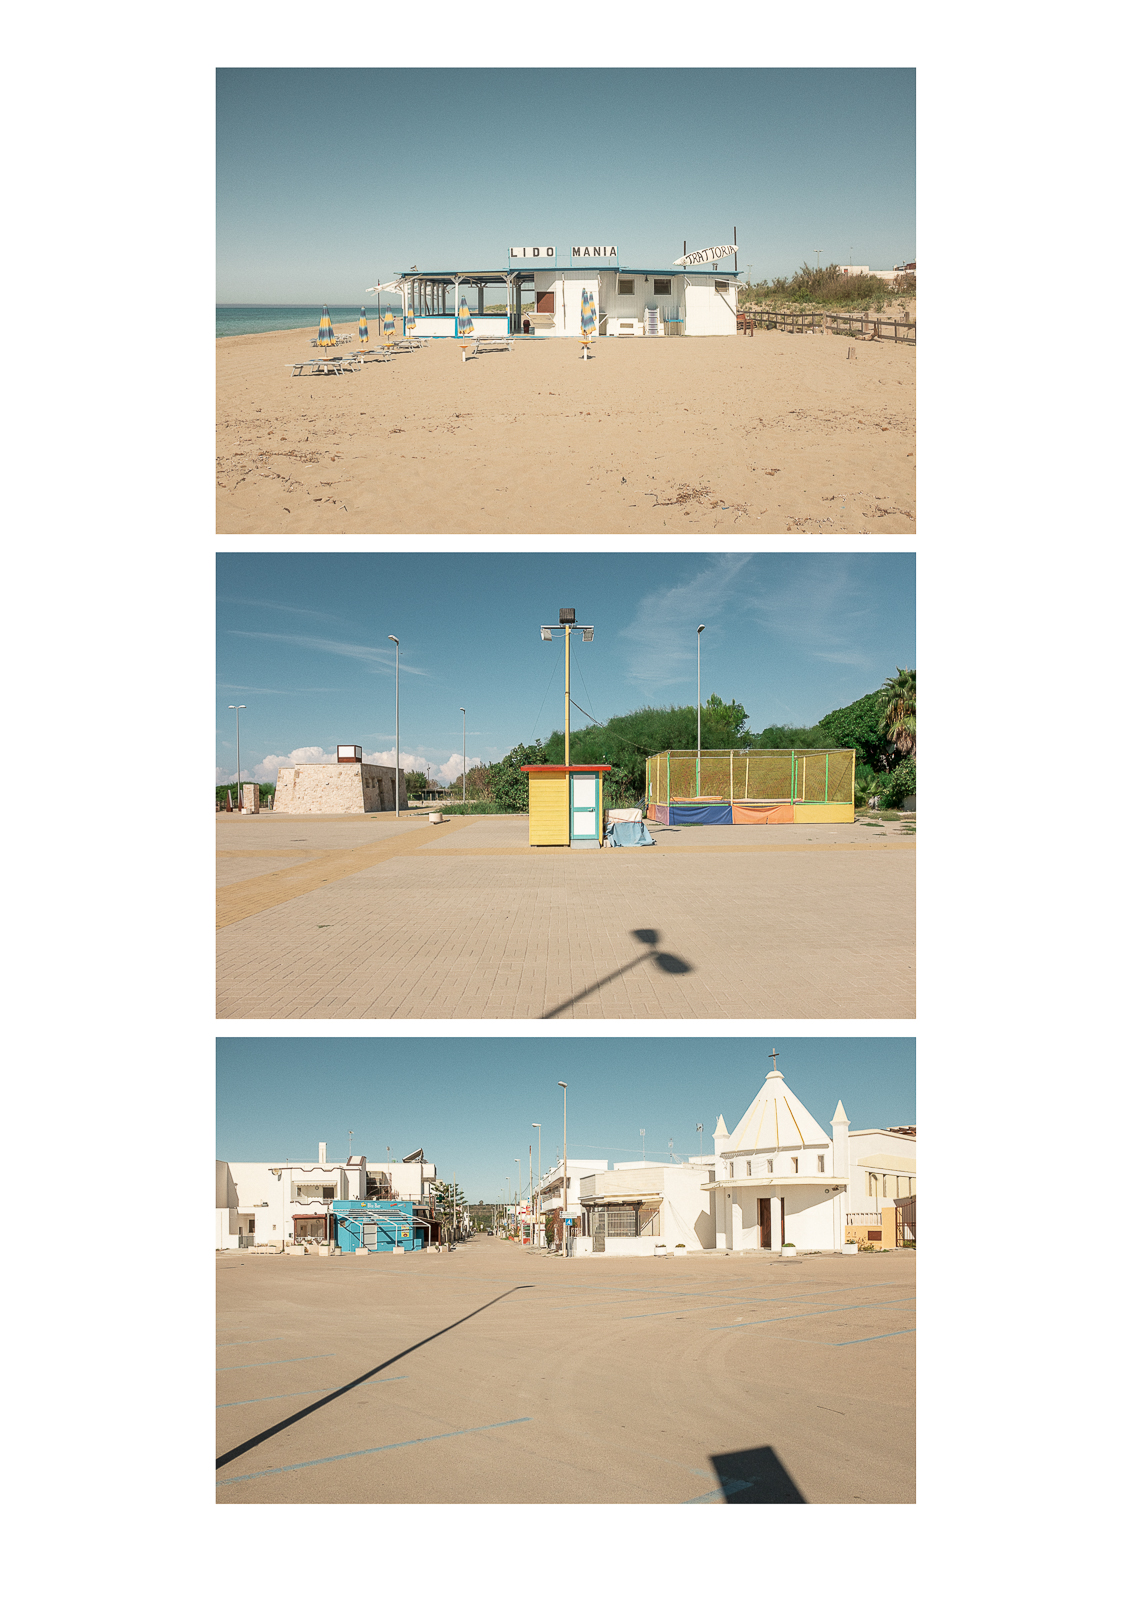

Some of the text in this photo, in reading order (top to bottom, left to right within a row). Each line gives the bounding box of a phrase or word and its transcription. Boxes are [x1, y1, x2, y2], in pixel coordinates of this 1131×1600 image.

[510, 246, 617, 257] LIDO MANIA
[685, 245, 736, 264] TRATTORIA
